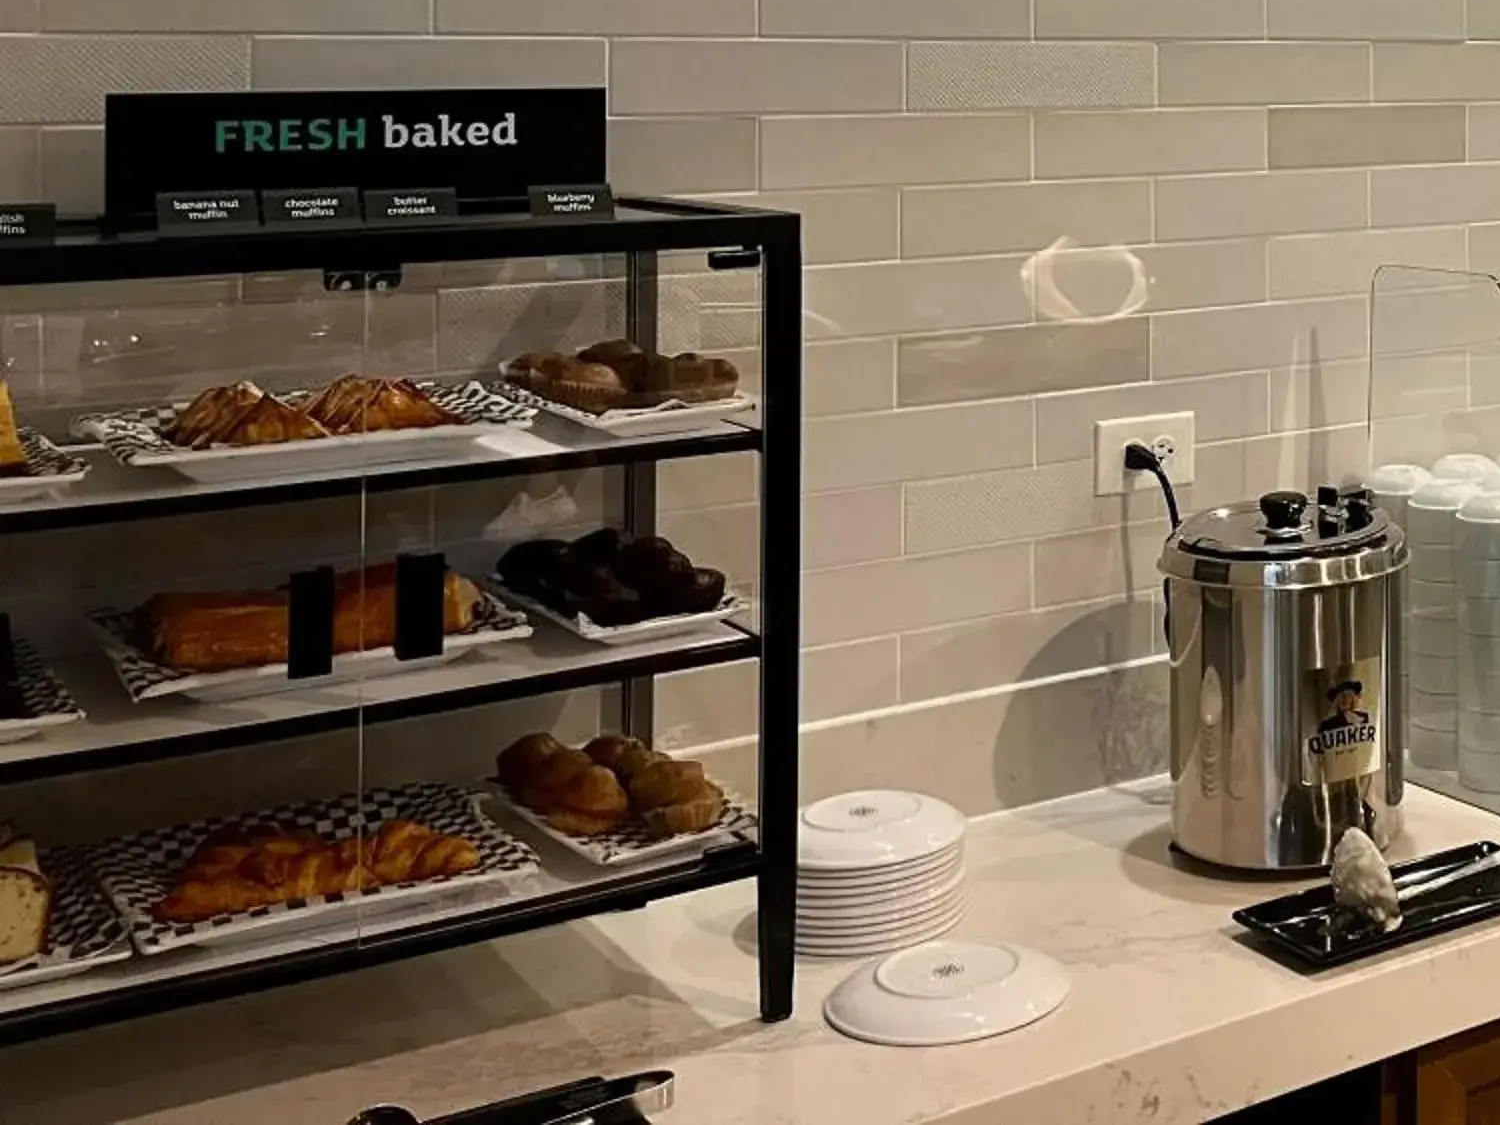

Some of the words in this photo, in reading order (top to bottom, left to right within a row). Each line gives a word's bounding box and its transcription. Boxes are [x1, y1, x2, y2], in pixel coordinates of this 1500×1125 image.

[214, 118, 366, 153] FRESH
[382, 112, 518, 149] baked
[173, 200, 217, 210] banana
[285, 198, 338, 208] chocolate
[291, 208, 335, 218] muffins
[1309, 725, 1377, 755] QUAKER
